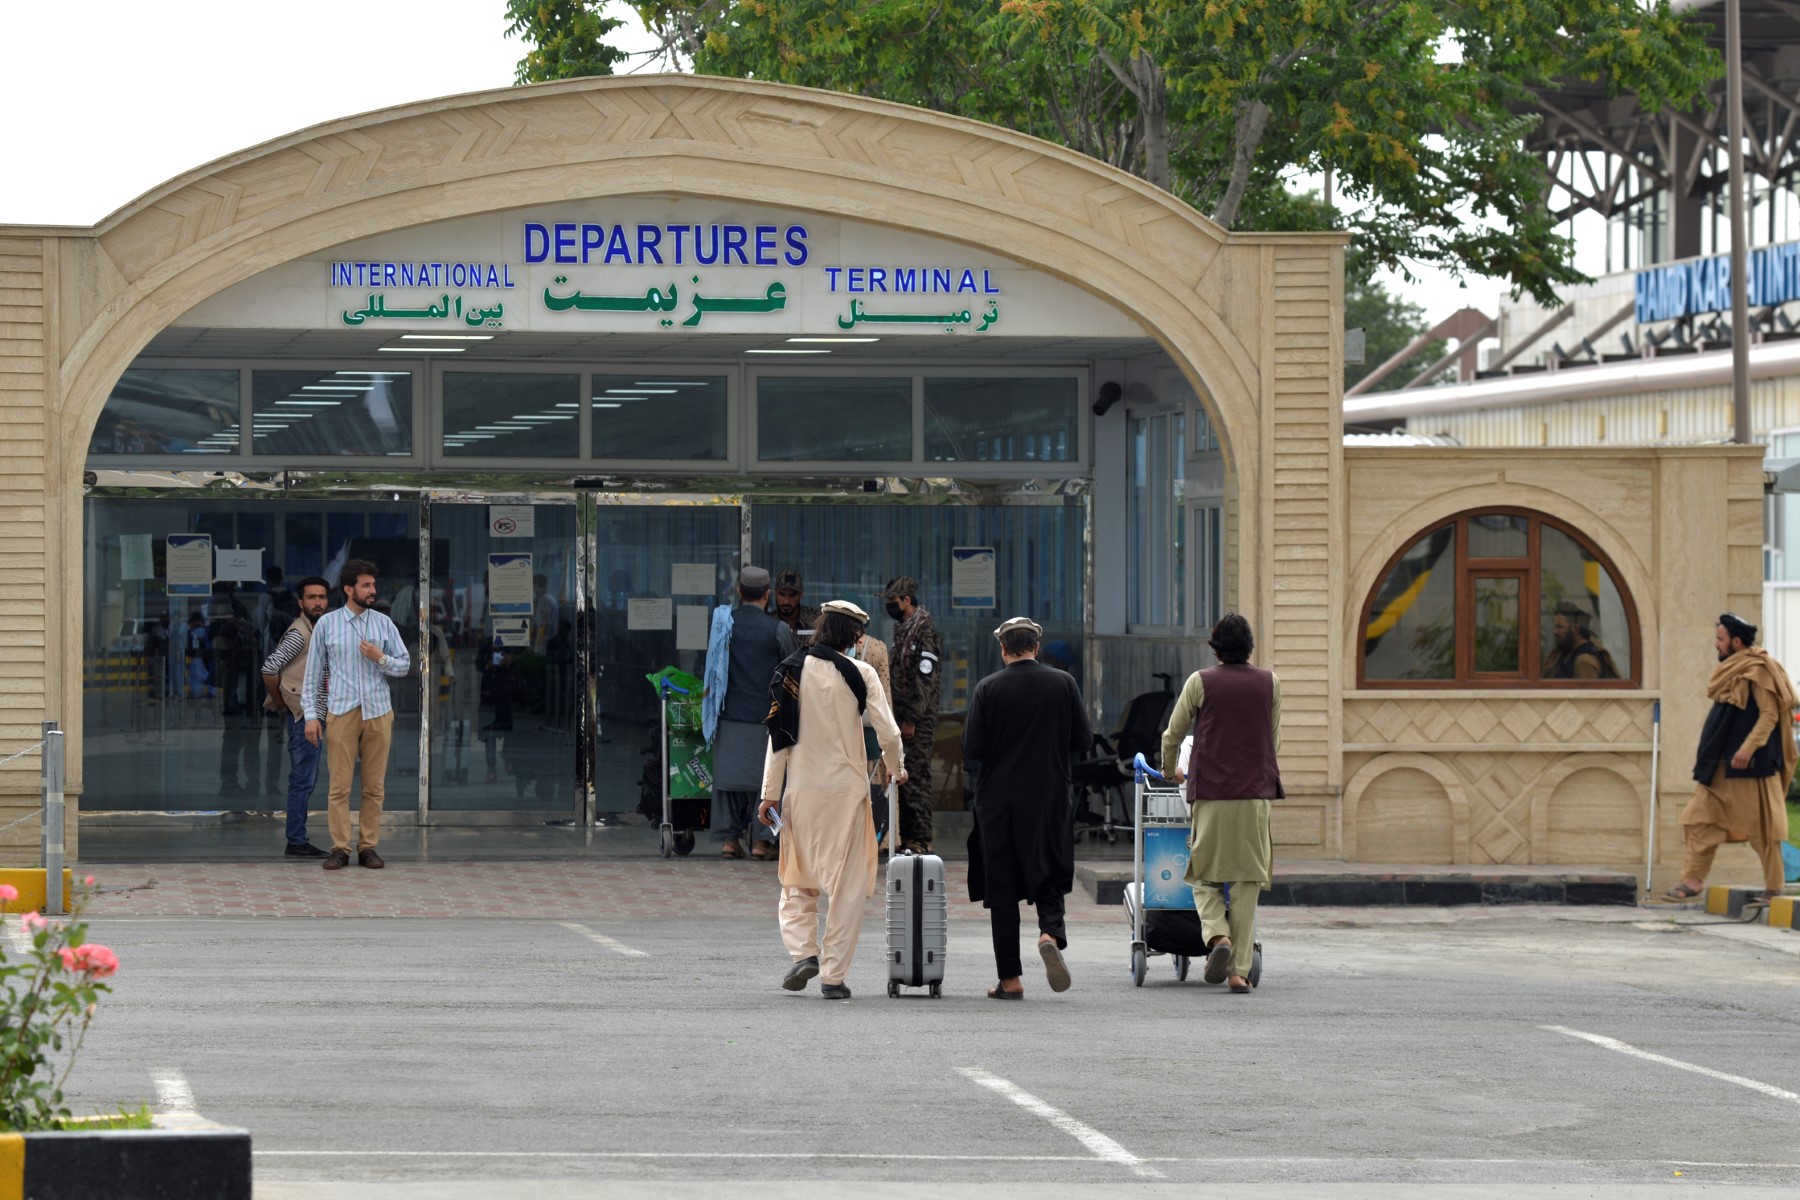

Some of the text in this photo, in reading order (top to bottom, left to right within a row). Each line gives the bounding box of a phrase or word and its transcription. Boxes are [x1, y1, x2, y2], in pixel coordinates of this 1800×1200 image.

[524, 223, 809, 267] DEPARTURES
[332, 262, 515, 288] INTERNATIONAL
[825, 267, 1000, 294] TERMINAL
[1635, 263, 1687, 324] HAMID
[1691, 249, 1764, 314] KARAI
[543, 275, 788, 328] عزیمت
